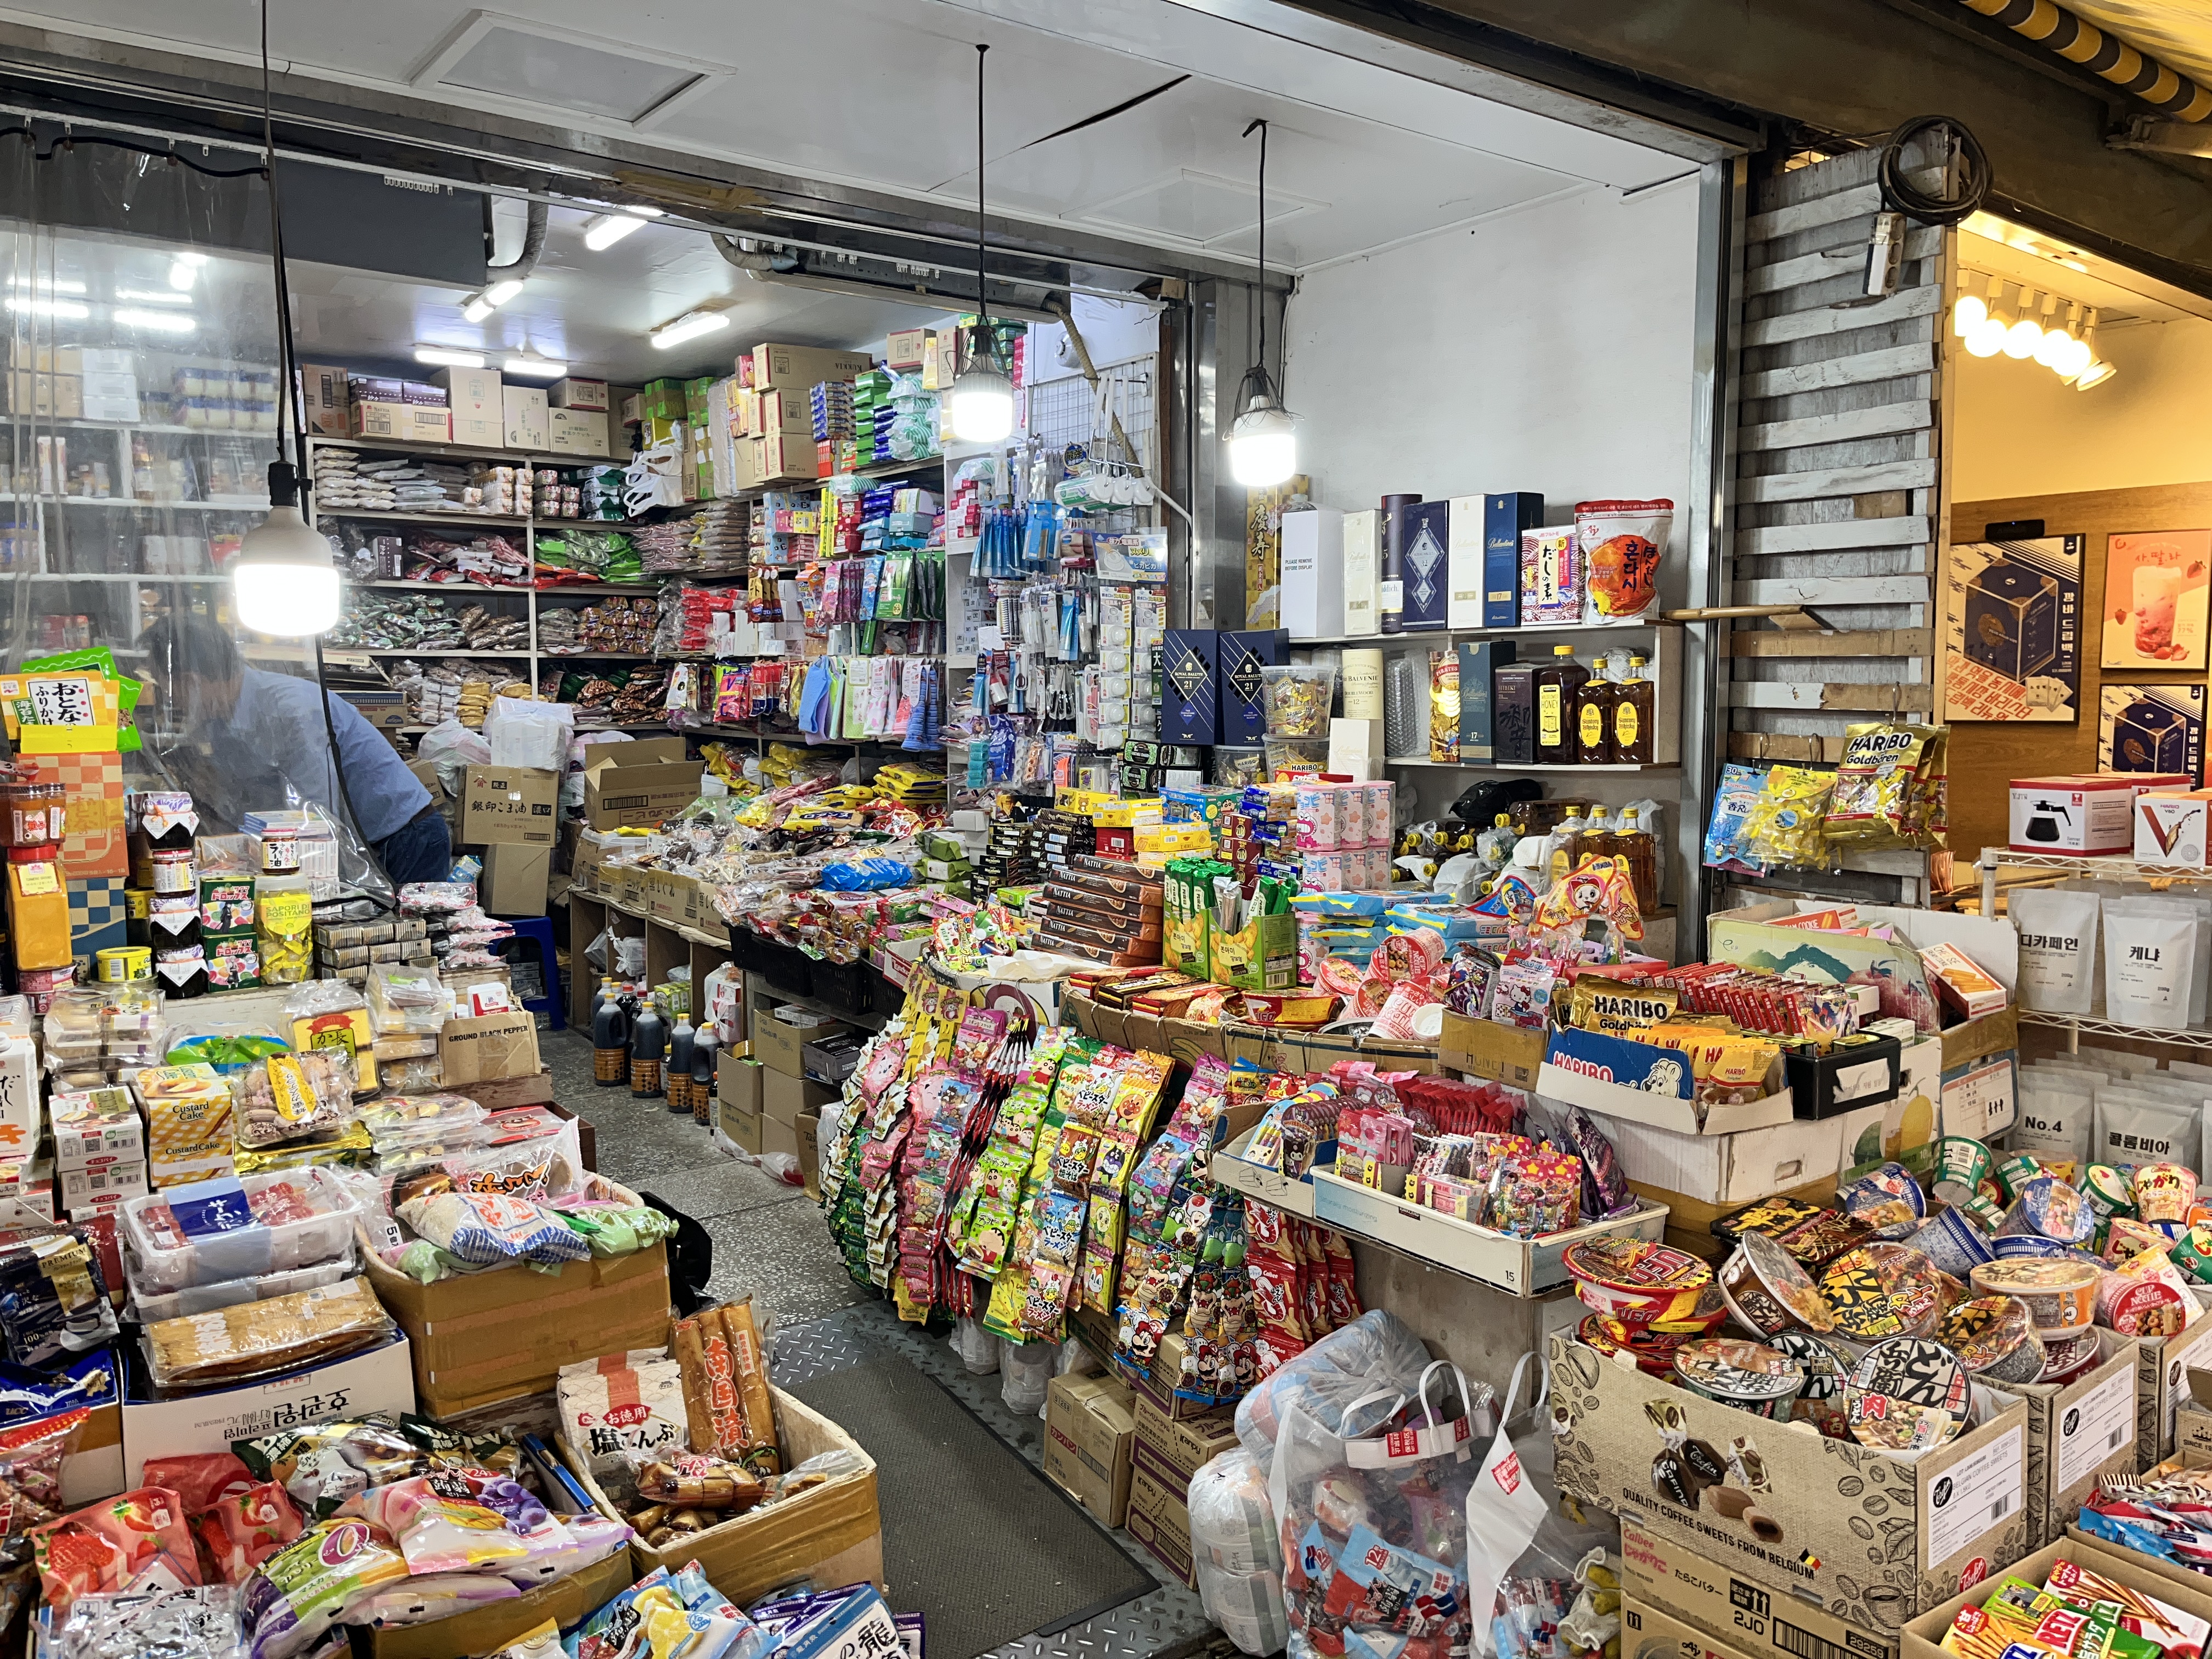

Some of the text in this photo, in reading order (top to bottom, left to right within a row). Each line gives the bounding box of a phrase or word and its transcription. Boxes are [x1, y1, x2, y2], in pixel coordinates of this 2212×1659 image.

[1542, 544, 1556, 601] だしの素
[1623, 540, 1639, 592] 혼다시
[1643, 546, 1656, 586] ほんだし
[1436, 666, 1459, 676] PIRATES
[1541, 700, 1559, 709] HONEY
[1848, 732, 1914, 753] HARIBO
[269, 844, 281, 867] ラー油
[1084, 858, 1101, 869] NATTIA
[1059, 871, 1076, 882] NATTIA
[212, 892, 247, 900] ドロップス
[1053, 887, 1071, 899] NATTIA
[266, 909, 310, 918] POSITANO
[1057, 906, 1074, 917] NATTIA
[1049, 921, 1065, 932] NATTIA
[1798, 918, 1818, 929] COOKIE
[1039, 935, 1054, 946] NATTIA
[1172, 933, 1185, 943] 본아미
[2021, 934, 2078, 951] 디카페인
[216, 946, 252, 956] ドロップス
[1220, 946, 1234, 955] 본아미
[2129, 946, 2160, 962] 케냐
[1513, 957, 1532, 967] HELLO
[1593, 995, 1668, 1020] HARIBO
[449, 1025, 528, 1043] GROUND BLACK PEPPER
[1553, 1052, 1613, 1083] HARIBO
[1079, 1089, 1108, 1105] ベビースター
[172, 1102, 209, 1114] Custard
[1077, 1099, 1100, 1112] ラーメン
[179, 1111, 205, 1120] Cake
[2025, 1115, 2063, 1133] No.4
[166, 1142, 220, 1155] Custard Cake
[2108, 1131, 2170, 1154] 콜롬비아
[1056, 1156, 1088, 1175] ベビースター
[1058, 1168, 1078, 1183] 焼そば
[1043, 1226, 1075, 1244] ベビースター
[1043, 1234, 1067, 1250] ラーメン
[42, 1247, 86, 1268] PREMIUM
[1263, 1269, 1278, 1279] Calbee
[1505, 1271, 1515, 1282] 15
[1025, 1294, 1059, 1315] ベビースター
[1026, 1306, 1052, 1322] ラーメン
[1617, 1307, 1660, 1323] UFO
[704, 1336, 748, 1448] 南国漬
[2108, 1386, 2123, 1401] SWEETS
[5, 1407, 29, 1415] UCC
[274, 1388, 351, 1426] 호관원
[607, 1407, 648, 1425] お徳用
[224, 1420, 272, 1440] 프리미엄
[590, 1423, 676, 1457] 塩こんぶ
[1051, 1426, 1077, 1453] カンパン
[1180, 1433, 1201, 1455] Kanpy
[2183, 1438, 2202, 1447] SINCE
[1953, 1475, 1972, 1491] BELGIAN
[1972, 1465, 1990, 1479] COFFEE
[1990, 1454, 2008, 1469] SWEETS
[1138, 1475, 1156, 1497] Kanpy
[1622, 1488, 1815, 1581] QUALITY COFFEE SWEETS FROM BELGIUM
[1623, 1528, 1655, 1550] Calbee
[1623, 1543, 1668, 1573] じゃがりこ
[1674, 1568, 1724, 1597] たらこバター
